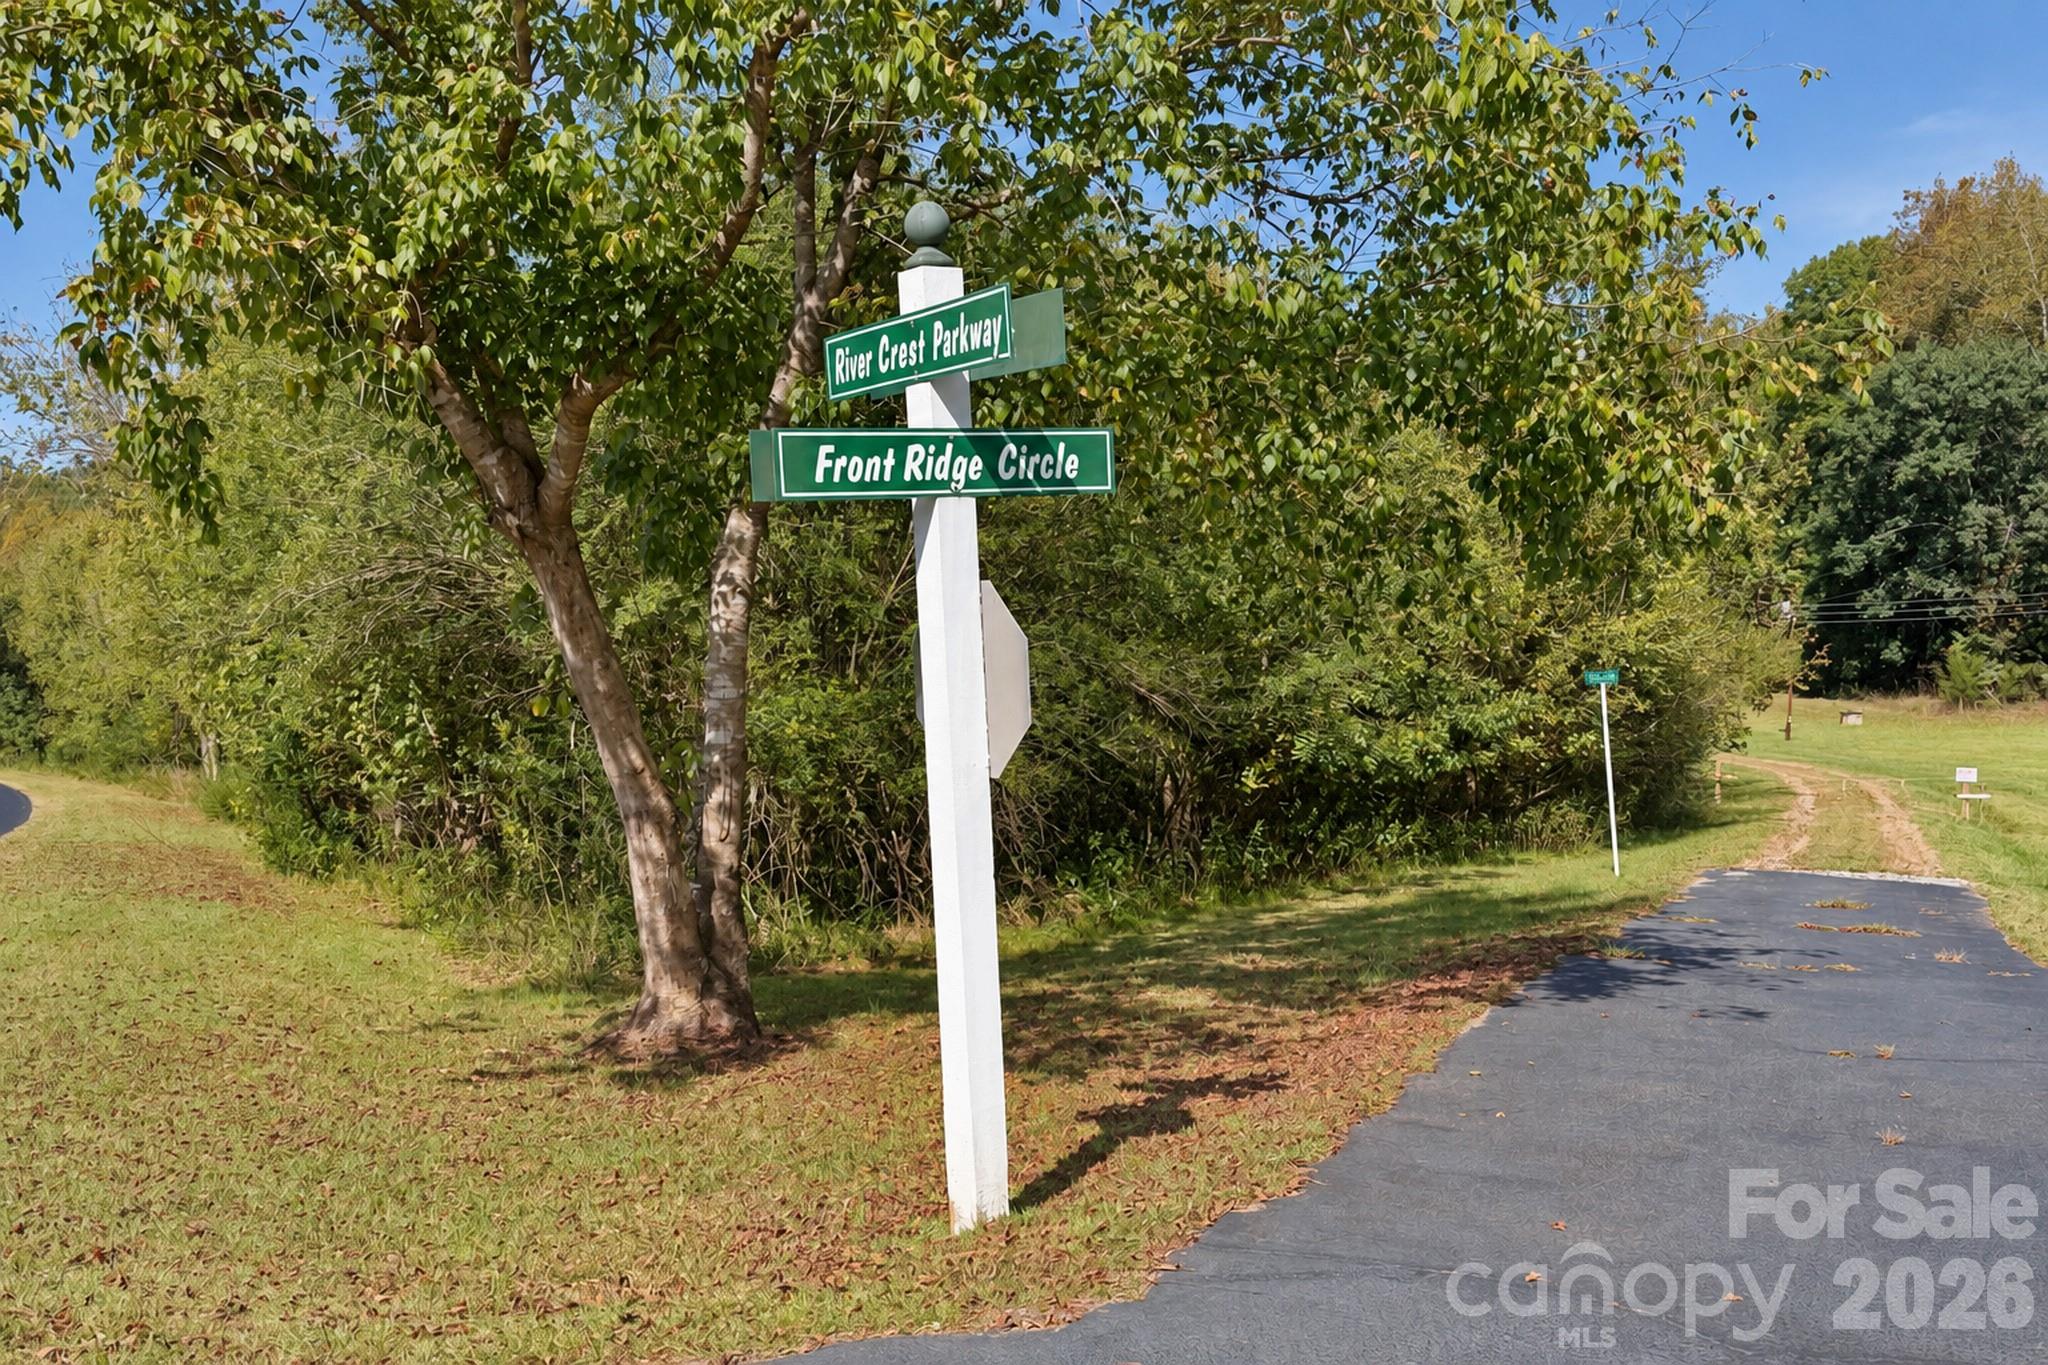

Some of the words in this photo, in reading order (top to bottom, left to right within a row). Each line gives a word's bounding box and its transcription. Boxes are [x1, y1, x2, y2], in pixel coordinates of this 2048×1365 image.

[835, 348, 871, 385] River
[878, 330, 925, 373] Crest
[932, 312, 1002, 360] Parkway
[815, 444, 895, 483] Front
[904, 442, 983, 491] Ridge
[998, 442, 1079, 480] Circle
